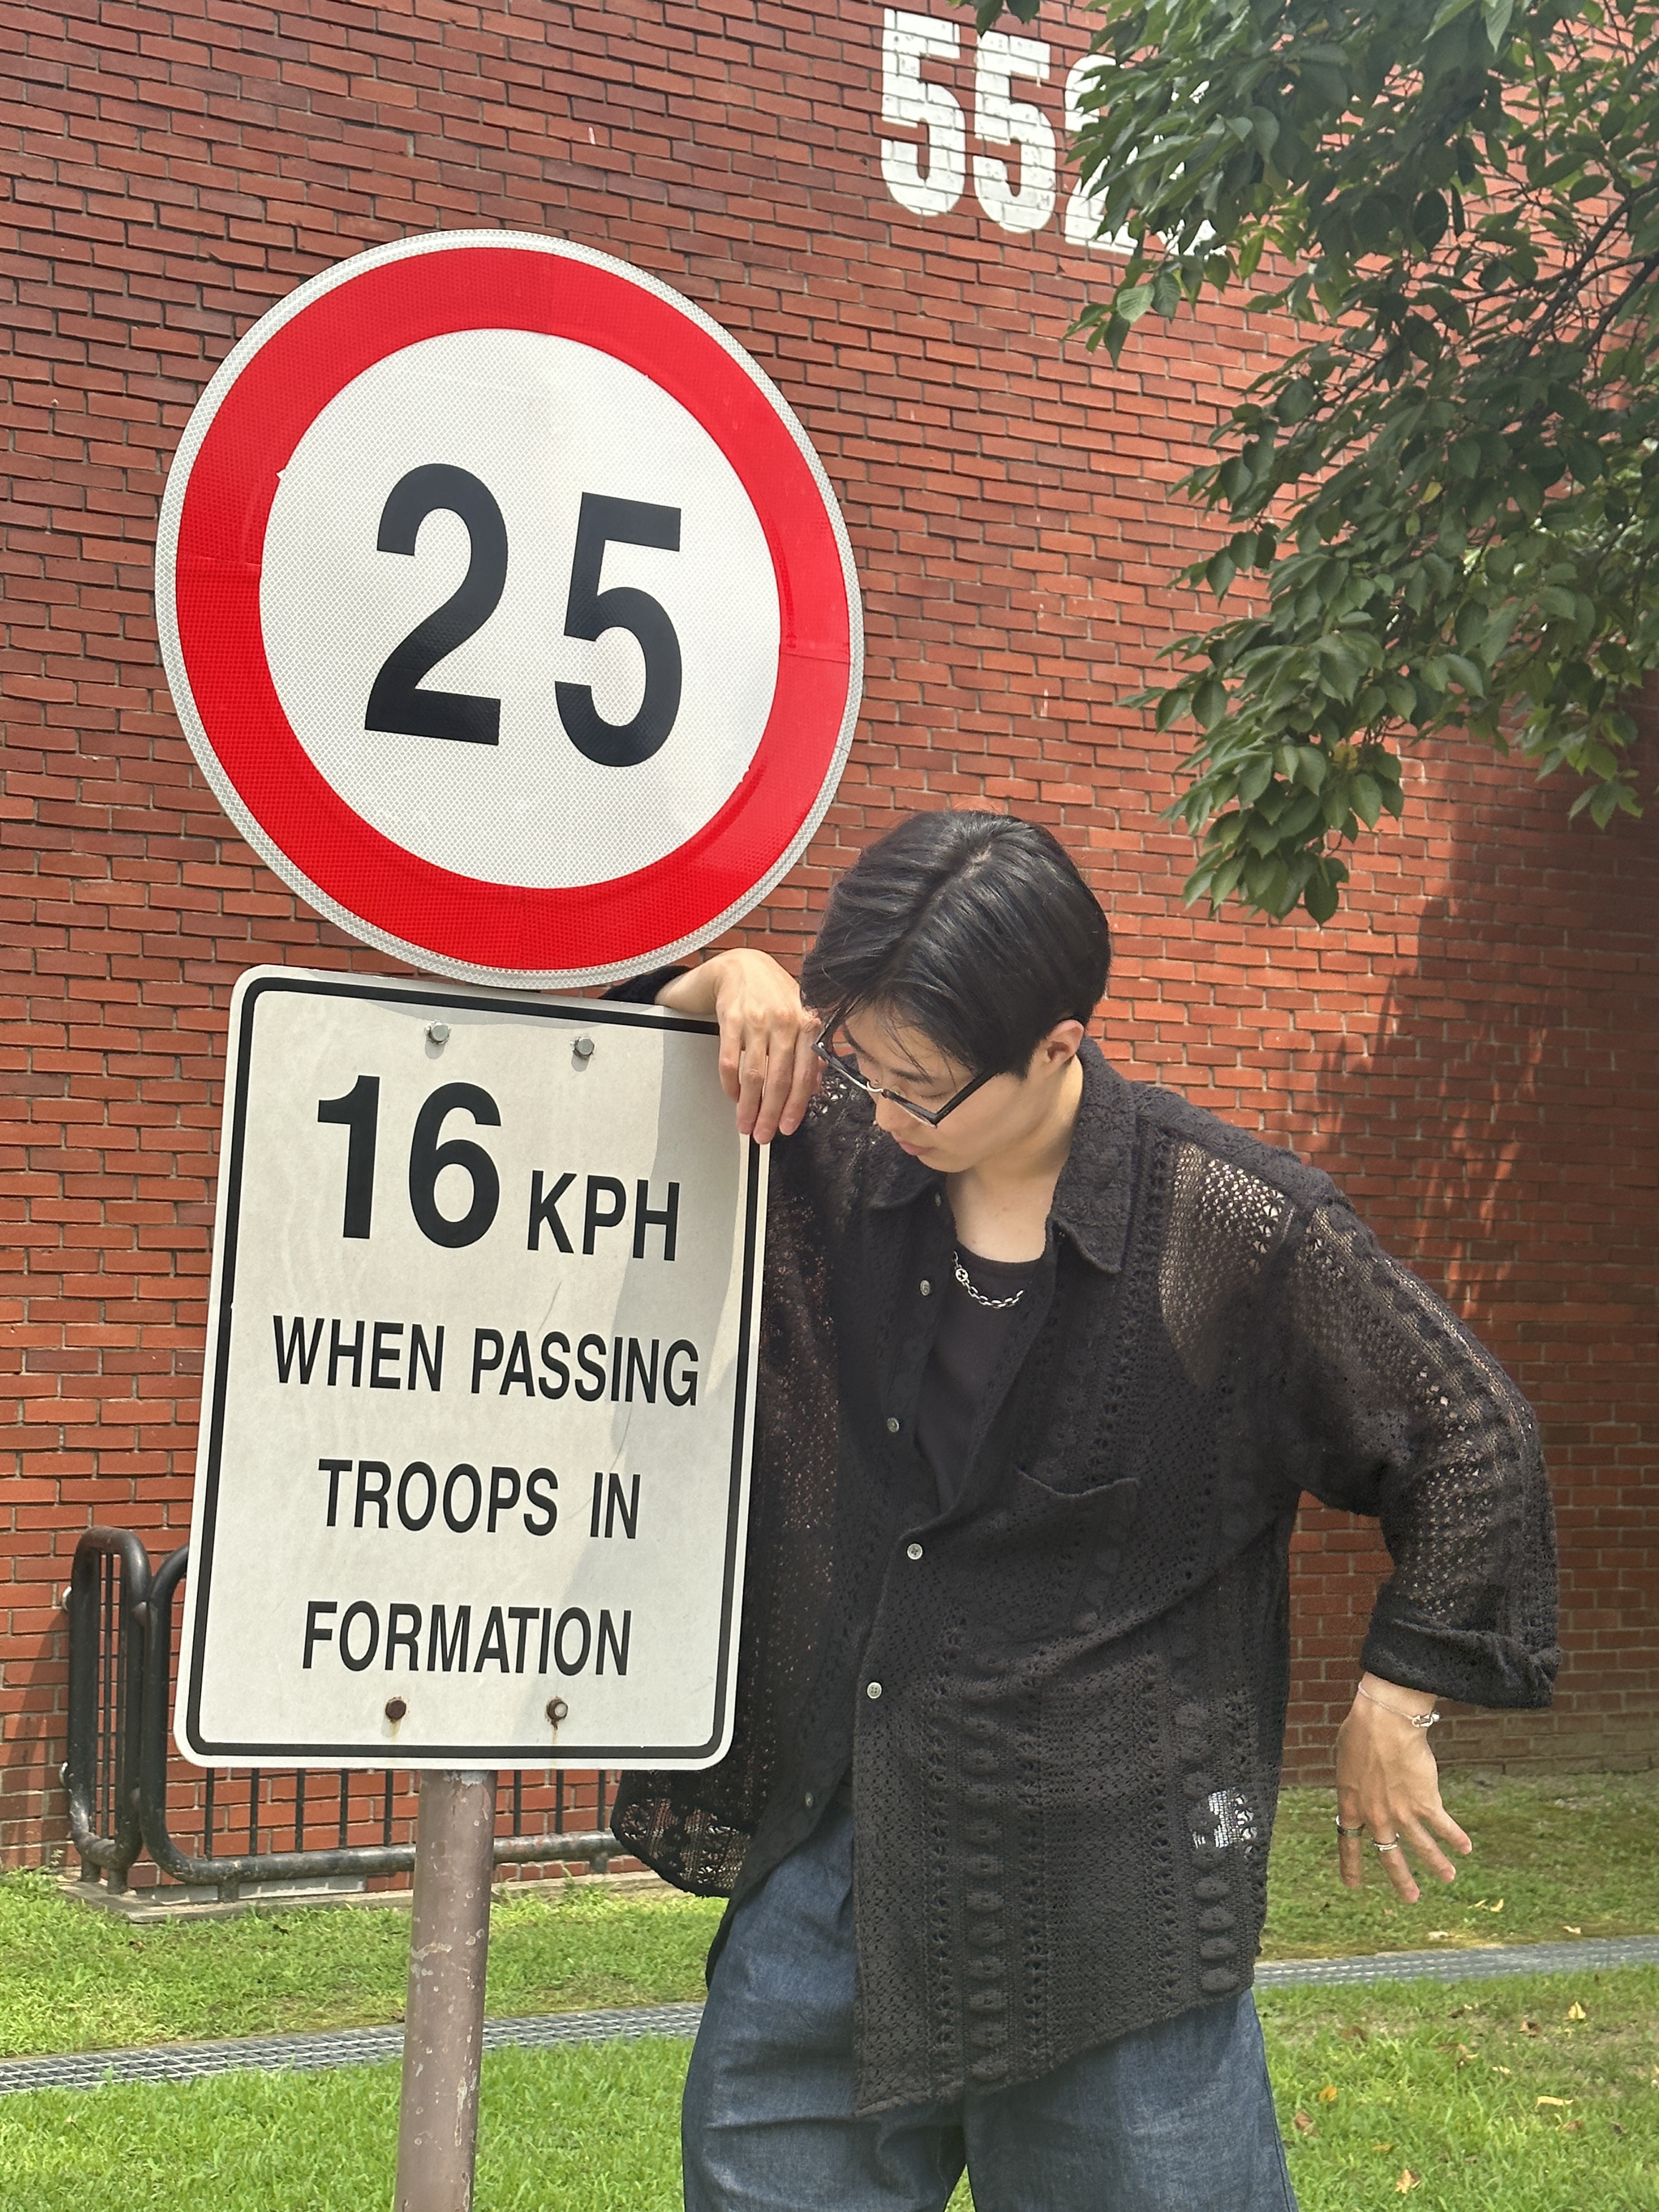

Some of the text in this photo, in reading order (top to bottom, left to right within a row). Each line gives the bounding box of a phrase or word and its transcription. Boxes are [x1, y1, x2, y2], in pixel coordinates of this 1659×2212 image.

[364, 463, 682, 768] 25
[317, 1075, 680, 1261] 16 KPH
[273, 1315, 698, 1407] WHEN PASSING
[318, 1458, 641, 1539] TROOPS IN
[302, 1601, 631, 1676] FORMATION
